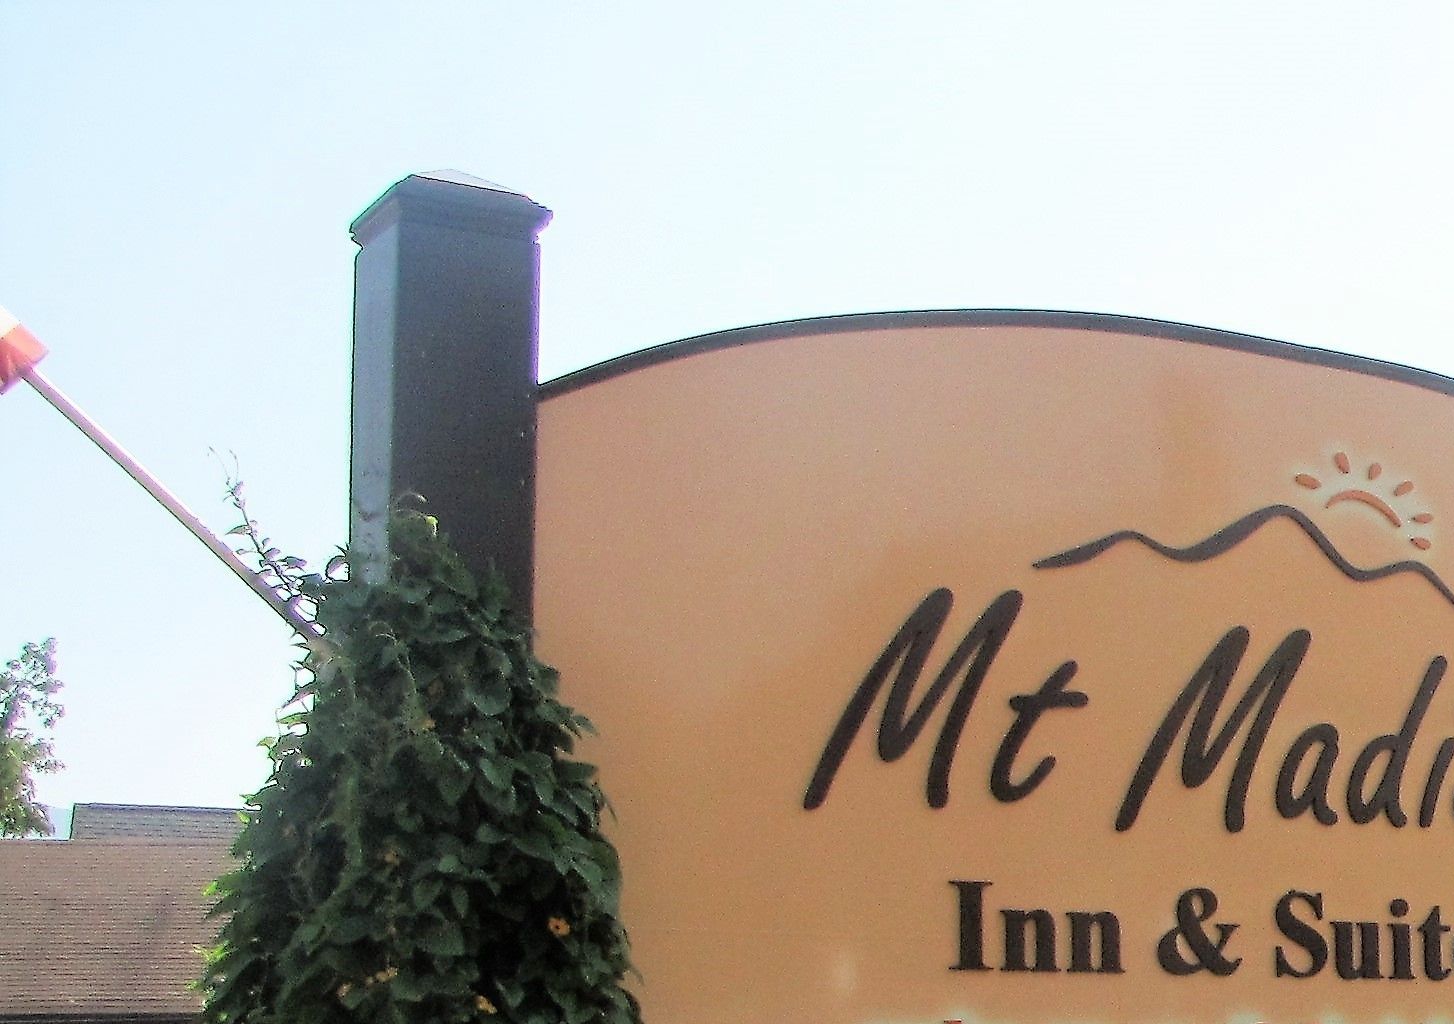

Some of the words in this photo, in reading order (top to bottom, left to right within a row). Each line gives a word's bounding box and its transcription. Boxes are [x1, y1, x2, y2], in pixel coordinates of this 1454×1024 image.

[803, 587, 1089, 809] Mt
[947, 878, 1126, 977] Inn
[1156, 886, 1243, 978] &
